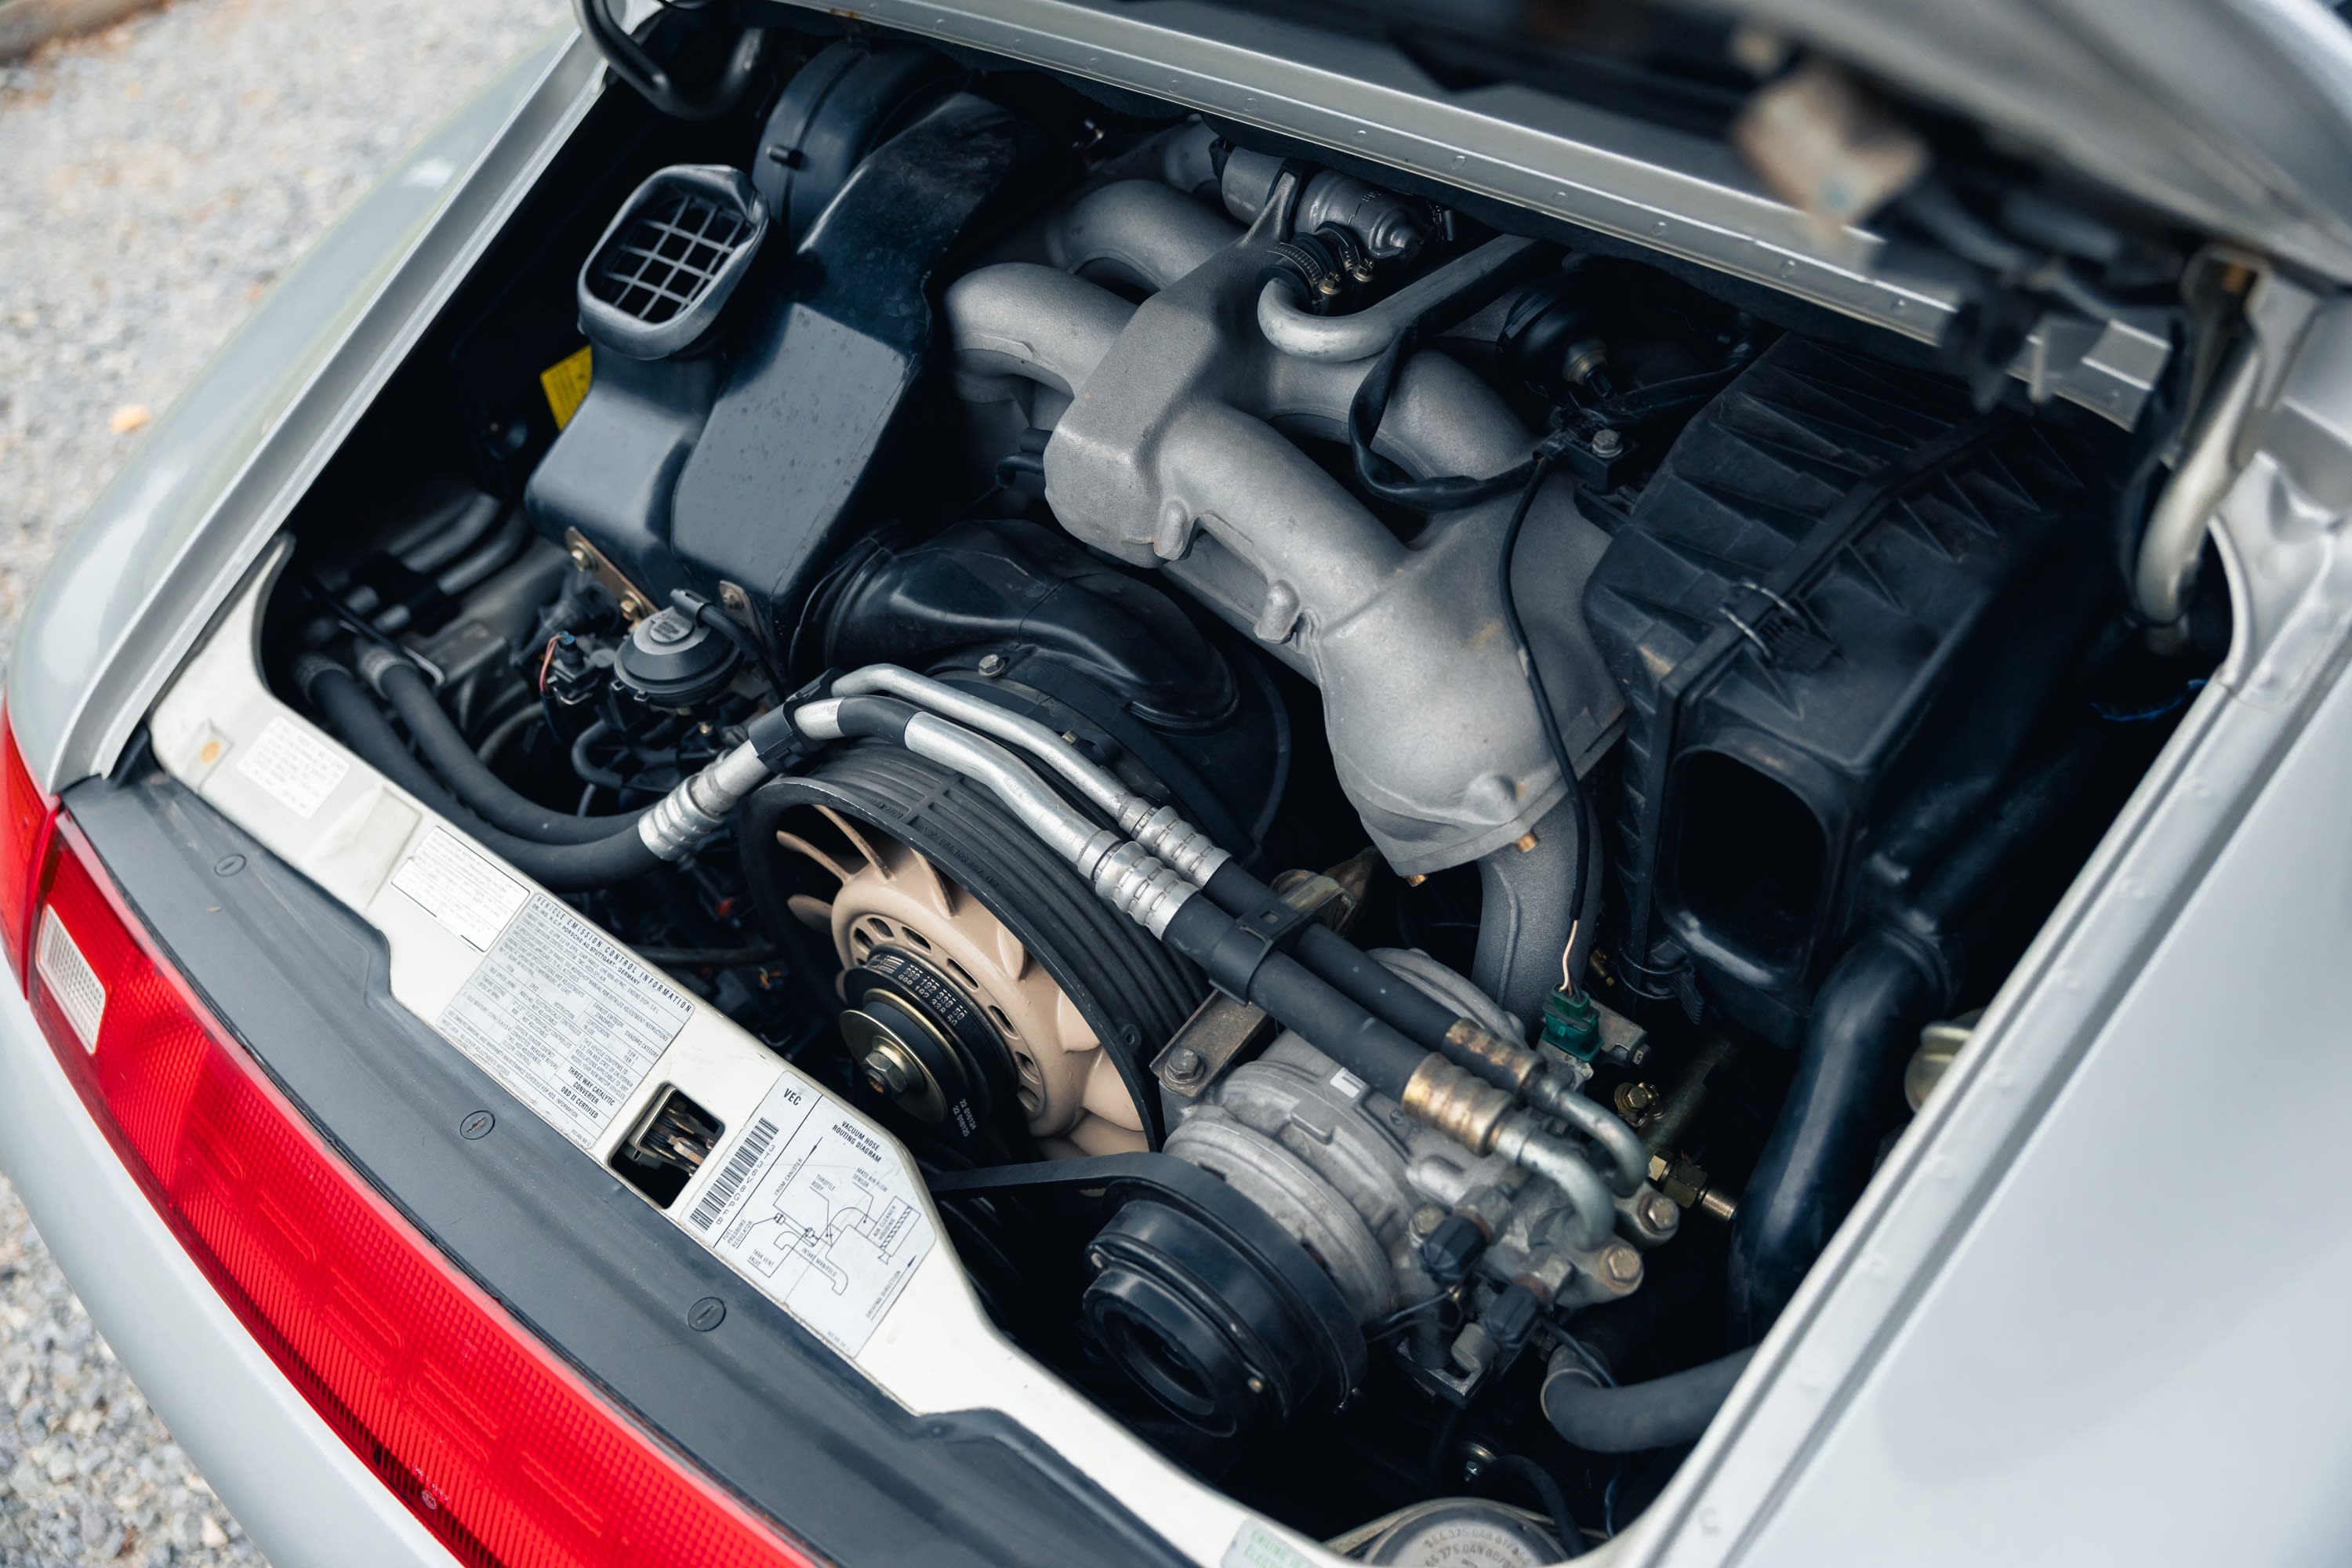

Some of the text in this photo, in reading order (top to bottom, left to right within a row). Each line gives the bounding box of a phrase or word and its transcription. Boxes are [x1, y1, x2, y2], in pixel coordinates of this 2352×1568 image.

[535, 895, 691, 1012] VEHICLE EMISSION CONTROL INFORMATION
[561, 925, 583, 943] PORSCHE
[589, 946, 615, 967] STUTTGART
[617, 967, 640, 985] GERMANY
[587, 979, 603, 992] MANUAL
[601, 989, 609, 997] FOR
[608, 994, 624, 1008] DETAILED
[622, 1005, 645, 1024] ADJUSTMENT
[537, 1008, 557, 1026] ADJUSTABLE
[592, 1002, 624, 1028] EXHAUST EMISSION
[594, 1011, 615, 1029] STANDARDS
[528, 1021, 548, 1038] ADJUSTABLE
[586, 1018, 610, 1039] CERTIFICATION
[626, 1049, 636, 1058] TIER
[527, 1034, 542, 1047] SENSOR
[539, 1044, 555, 1058] CONTACT
[529, 1044, 546, 1060] MEASURE
[544, 1057, 558, 1070] BEFORE
[623, 1030, 659, 1058] STANDARD CATEGORY
[570, 1054, 583, 1066] MODEL
[581, 1062, 591, 1073] YEAR
[590, 1069, 599, 1079] NEW
[597, 1075, 611, 1087] MOTOR
[574, 1048, 597, 1068] REGULATIONS
[595, 1065, 616, 1083] APPLICABLE
[590, 1044, 605, 1057] VEHICLE
[604, 1054, 623, 1071] CONFORMS
[591, 1053, 601, 1062] AND
[599, 1059, 610, 1069] STATE
[612, 1070, 633, 1087] CALIFORNIA
[622, 1054, 632, 1064] TIER
[524, 1072, 542, 1088] SCHEDULE
[554, 1097, 579, 1118] INFORMATION
[567, 1066, 615, 1106] THREE WAY CATALYTIC
[572, 1081, 600, 1105] CONVERTER
[782, 1087, 802, 1106] VEC
[560, 1085, 572, 1097] OBD
[575, 1098, 599, 1119] CERTIFIED
[831, 1123, 881, 1163] ROUTING DIAGRAM
[840, 1120, 880, 1151] VACUUM HOSE
[784, 1157, 803, 1182] CANISTER
[815, 1173, 836, 1192] THROTTLE
[851, 1172, 869, 1189] SENSOR
[856, 1167, 888, 1192] MASS AIR FLOW
[811, 1180, 823, 1192] BODY
[879, 1204, 896, 1229] CLEANER
[727, 1218, 746, 1244] PRESSURE
[731, 1219, 753, 1248] REGULATOR
[748, 1254, 760, 1266] VALVE
[752, 1248, 775, 1268] TANK VENT
[801, 1247, 837, 1277] INTAKE MANIFOLD
